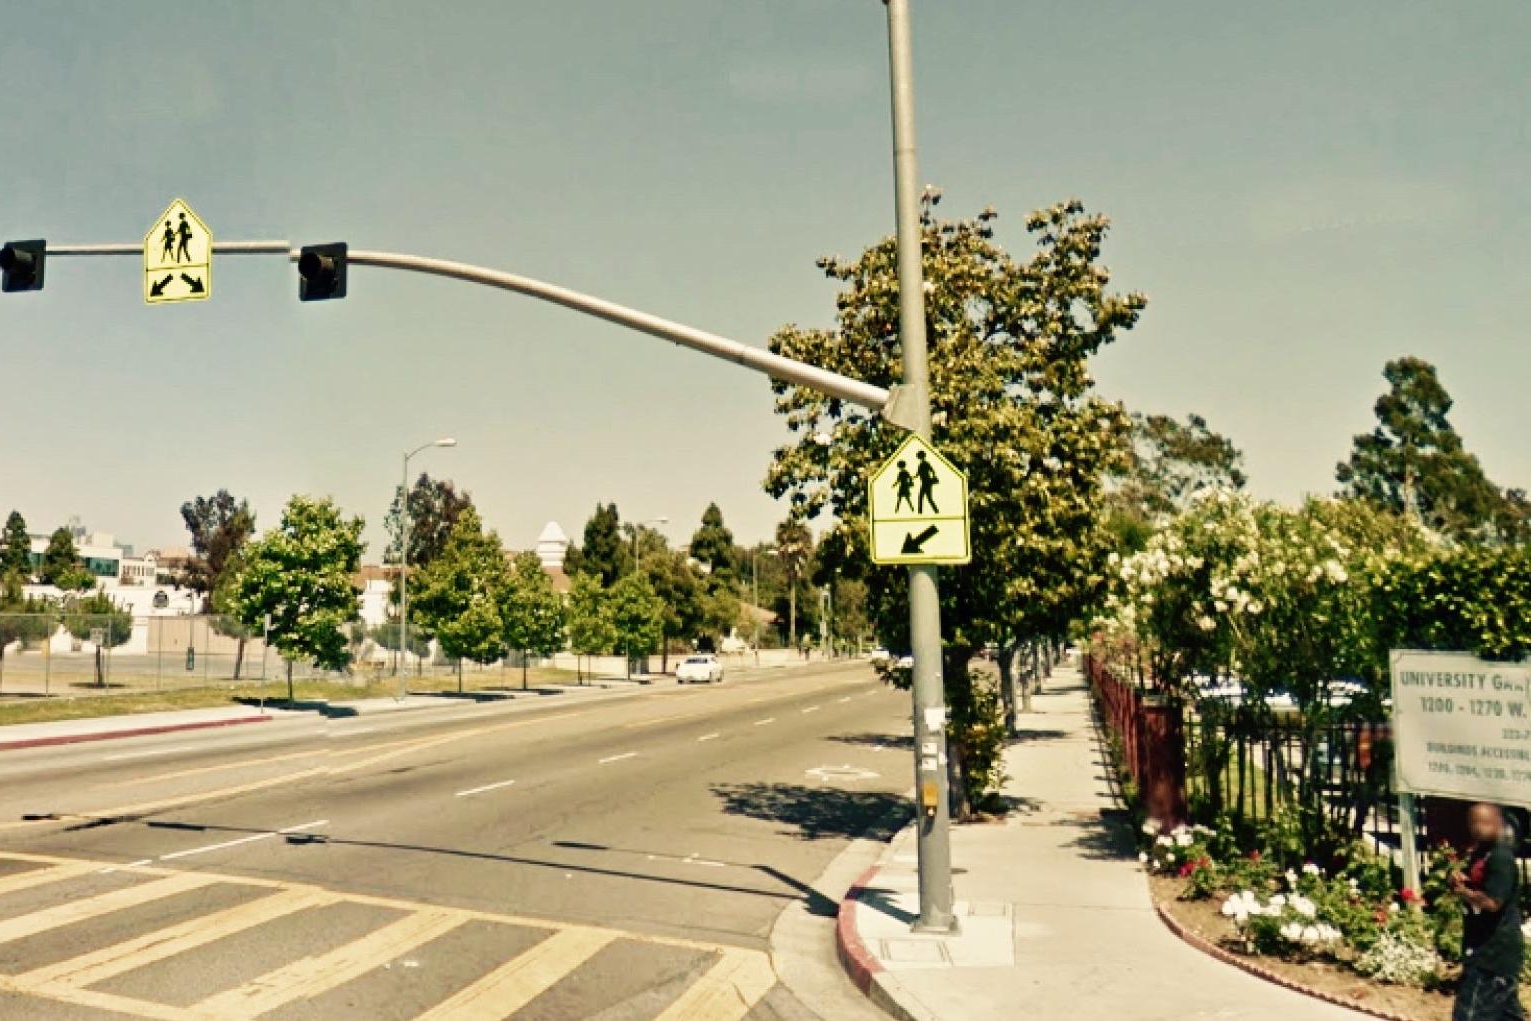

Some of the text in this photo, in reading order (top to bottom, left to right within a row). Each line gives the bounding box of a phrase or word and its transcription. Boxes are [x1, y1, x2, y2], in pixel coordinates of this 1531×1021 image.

[1400, 671, 1486, 689] UNIVERSITY
[1421, 697, 1453, 713] 1200
[1471, 699, 1503, 717] 1270
